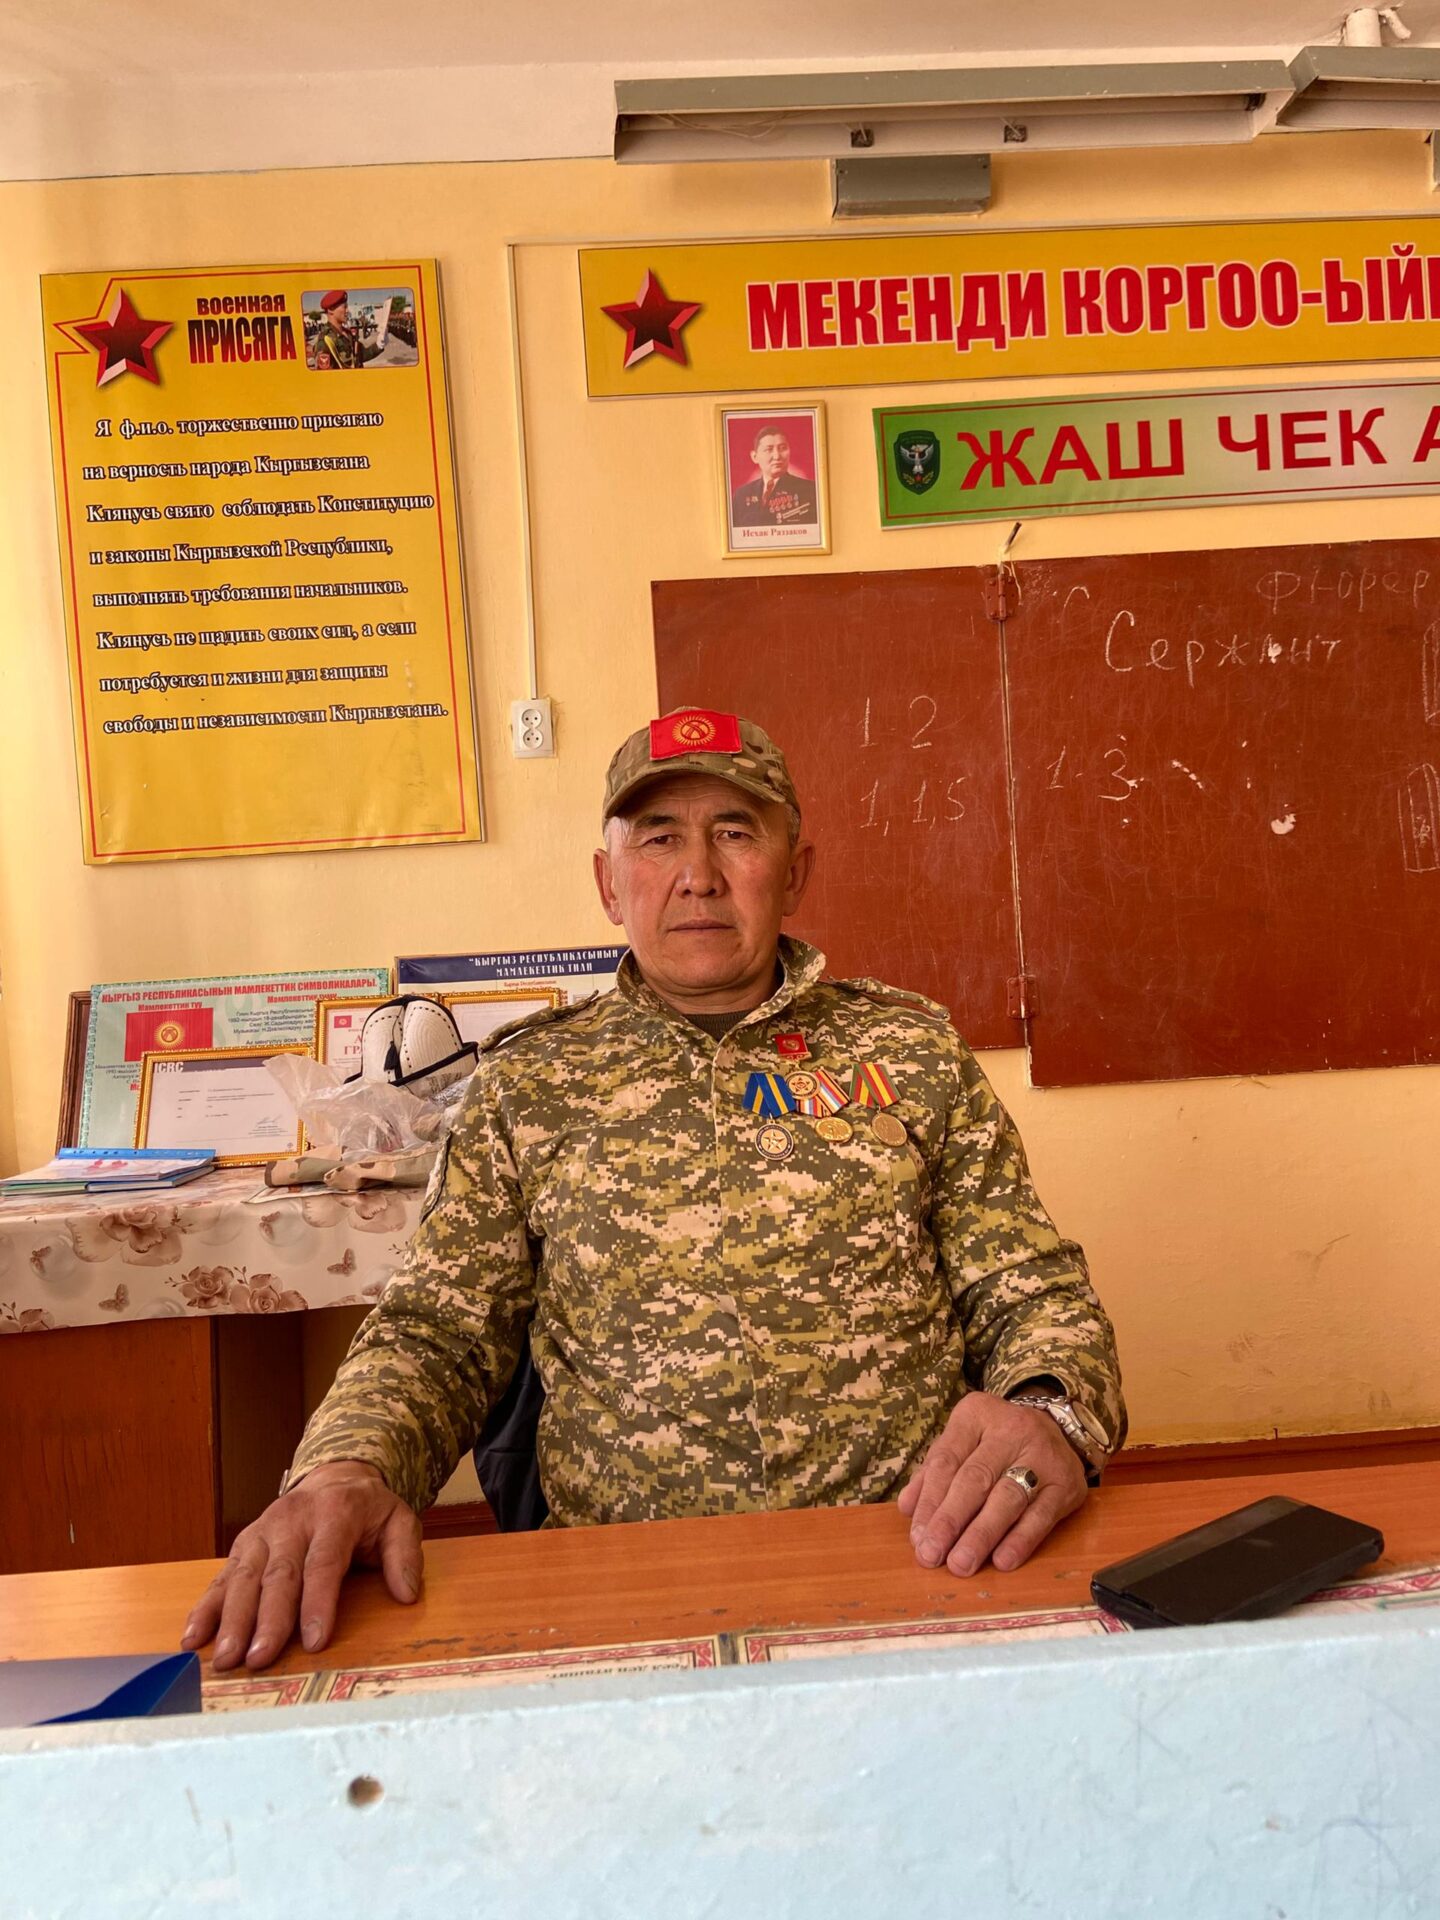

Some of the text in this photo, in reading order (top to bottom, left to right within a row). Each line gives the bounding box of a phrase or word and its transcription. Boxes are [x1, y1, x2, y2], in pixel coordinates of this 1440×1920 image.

[746, 243, 1440, 353] МЕКЕНДИ КОРГОО-ЫЙ
[186, 314, 297, 363] ПРИСЯГА
[95, 411, 384, 439] Я ф.и.о. торжественно присягаю
[956, 418, 1186, 491] ЖАШ
[1217, 406, 1389, 472] ЧЕК
[83, 453, 370, 483] на верность народа Кыргызстана
[87, 492, 435, 525] Клянусь свято соблюдать Конституцию
[742, 528, 807, 538] Исхак Раззаков
[89, 536, 394, 566] и законы Кыргызской Республики,
[93, 578, 408, 609] выполнять требования начальников.
[96, 618, 417, 652] Клянусь не щадить своих сил, а если
[99, 662, 389, 695] потребуется и жизни для защиты
[103, 701, 450, 737] свободы и независимости Кыргызстана.
[496, 962, 593, 977] МАМЛЕКЕТТИК ТИЛИ
[102, 991, 141, 1003] КЫРГЫЗ
[142, 986, 233, 1001] РЕСПУБЛИКАСЫНЫН
[234, 981, 297, 995] МАМЛЕКЕТТИК
[154, 1060, 184, 1074] ICRC
